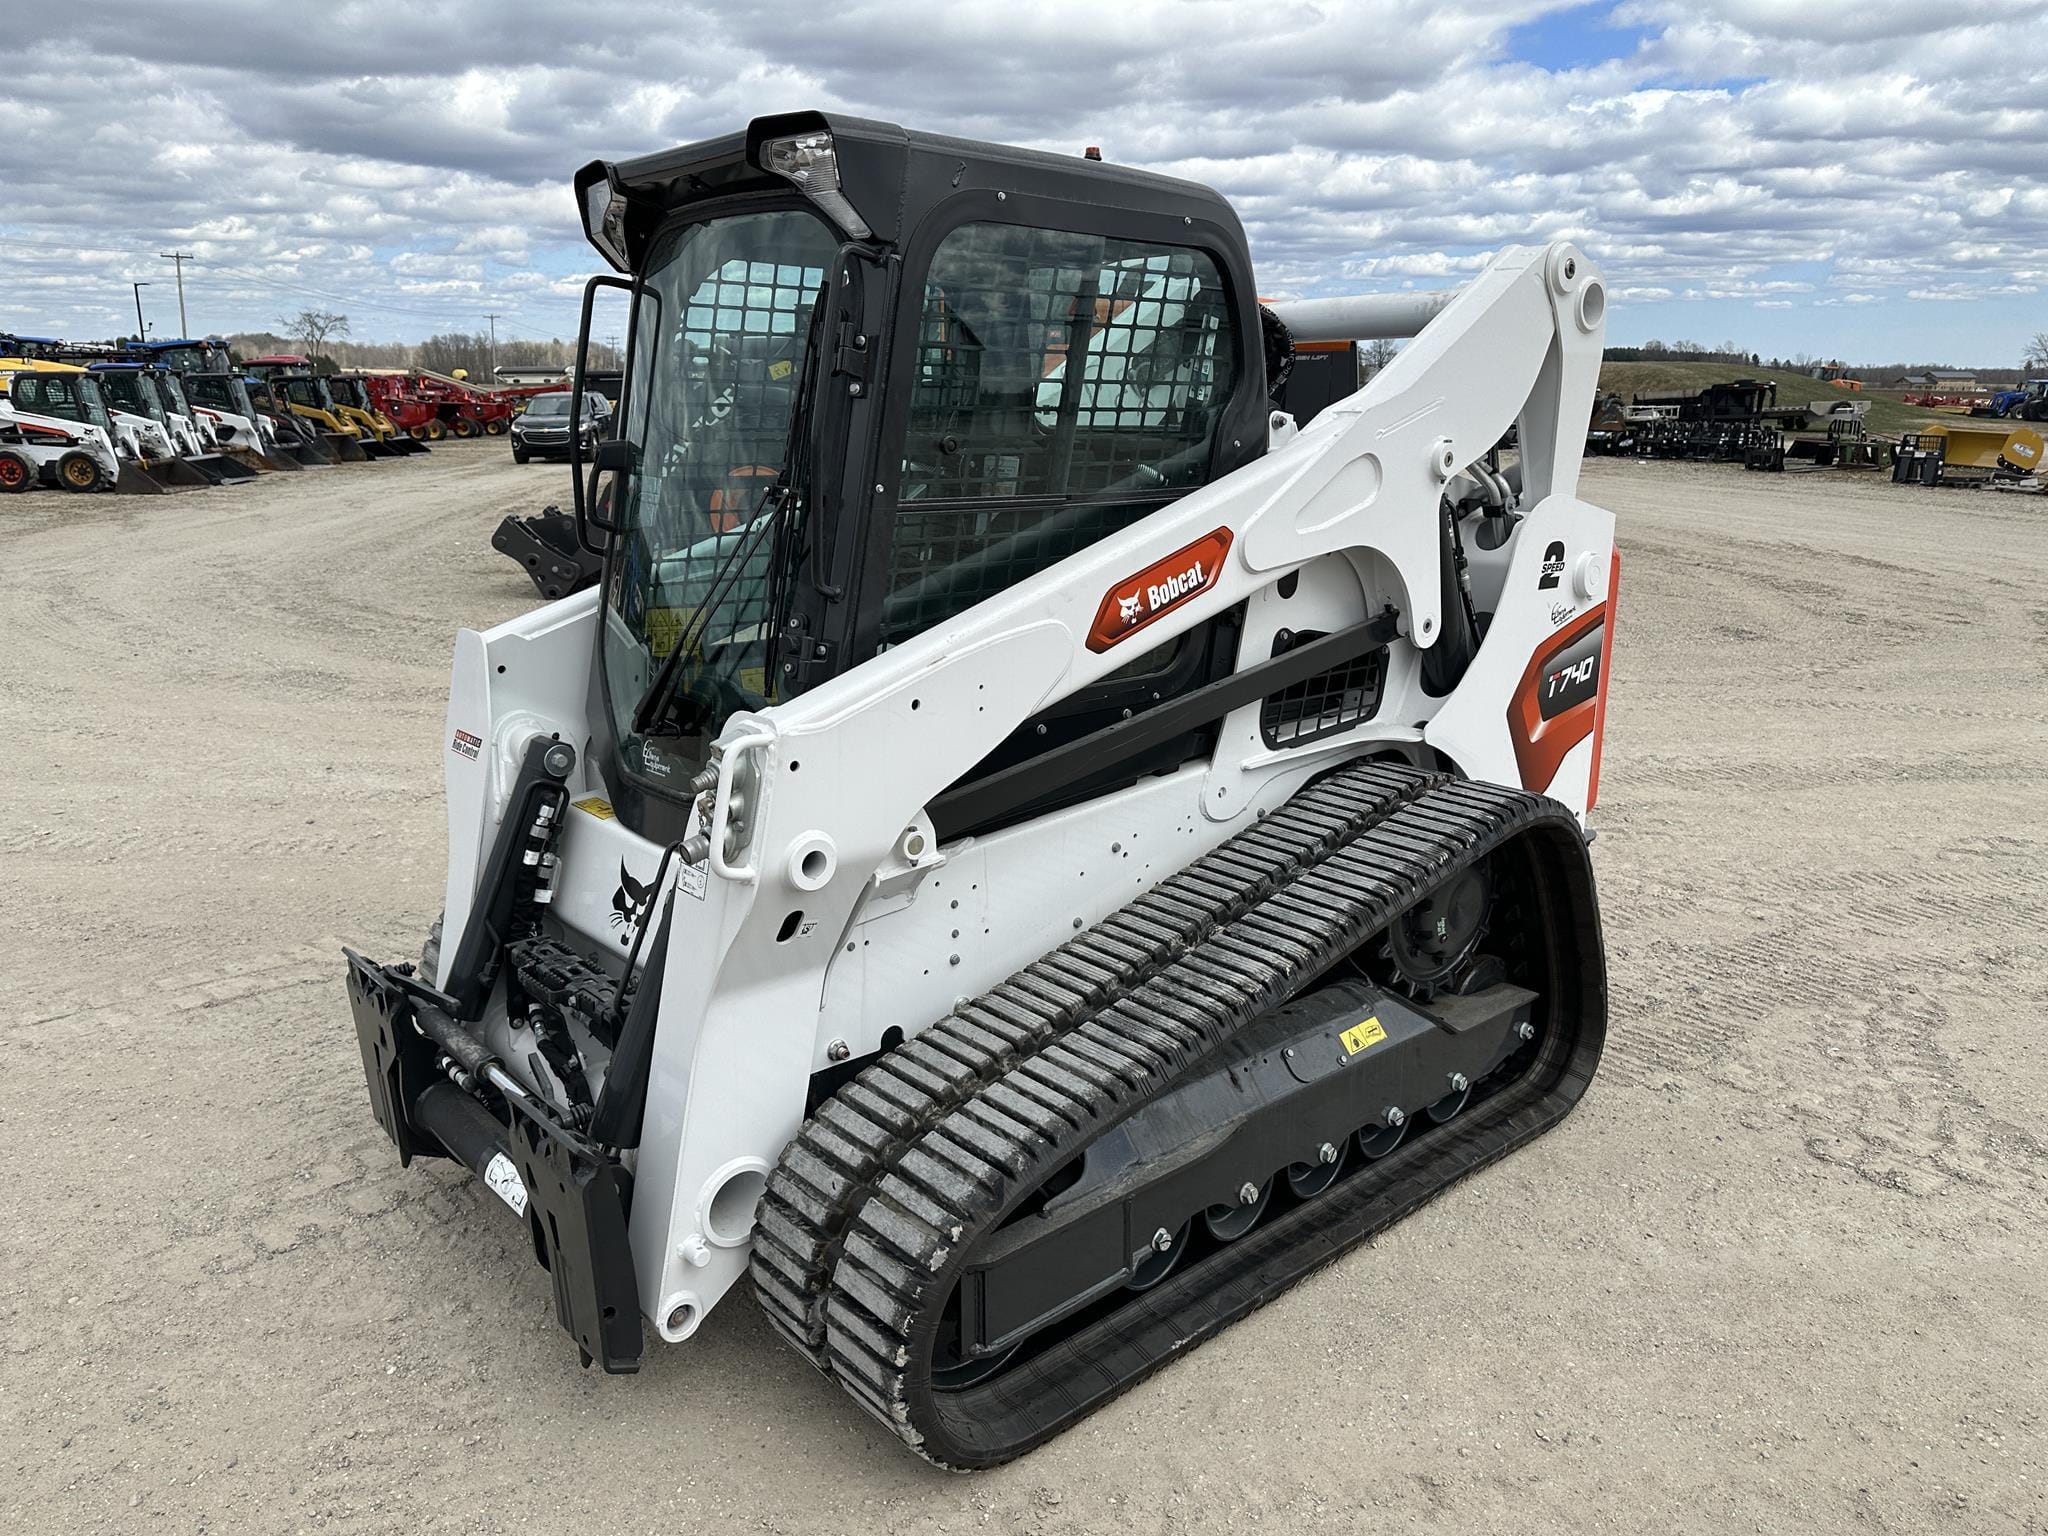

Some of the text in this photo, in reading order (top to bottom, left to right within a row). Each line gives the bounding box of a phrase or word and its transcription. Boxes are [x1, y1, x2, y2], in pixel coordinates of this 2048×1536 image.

[1538, 541, 1565, 590] 2
[1541, 561, 1565, 574] SPEED
[1147, 560, 1204, 611] Bobcat
[451, 738, 480, 760] Ride Control
